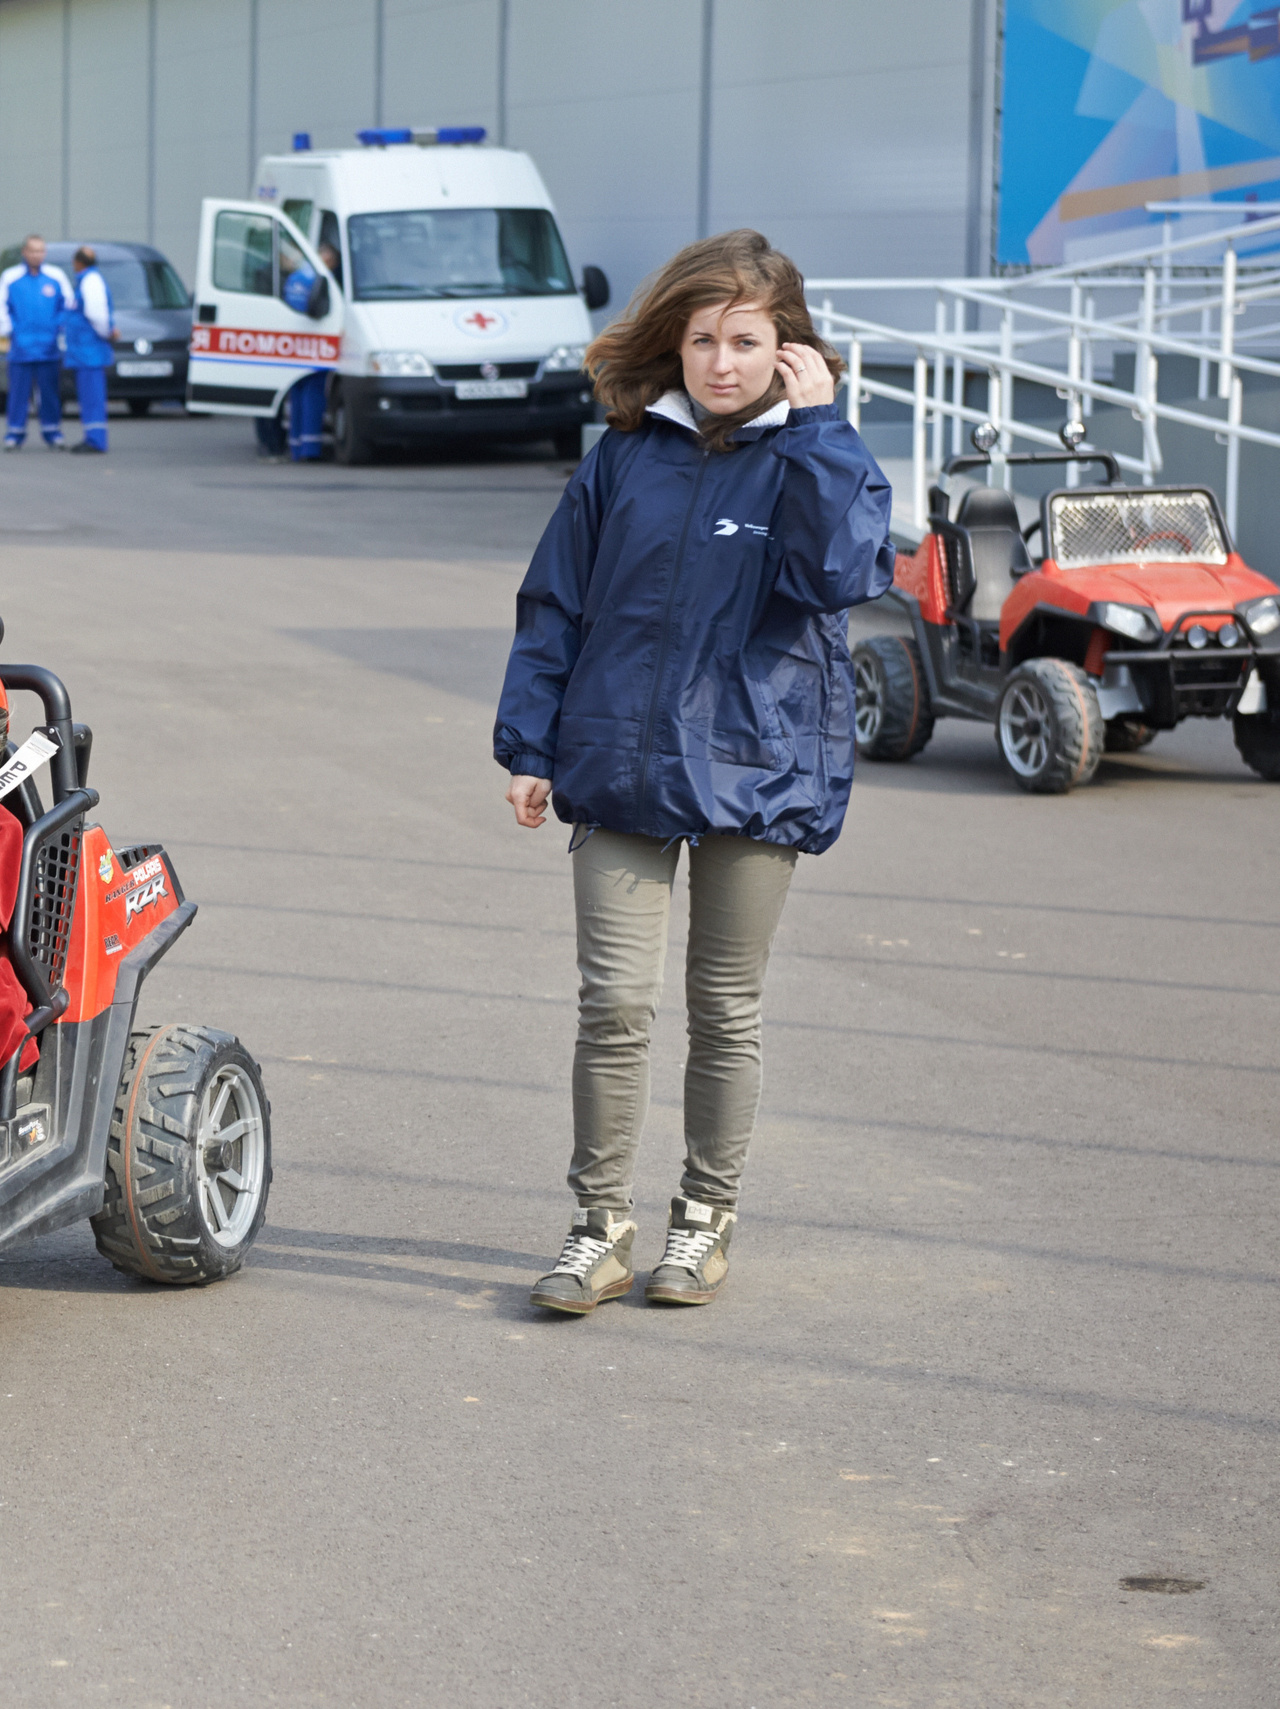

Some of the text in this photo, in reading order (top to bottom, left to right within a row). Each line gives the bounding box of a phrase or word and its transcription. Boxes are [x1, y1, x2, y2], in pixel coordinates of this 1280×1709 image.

[219, 331, 337, 360] ПОМОЩЬ
[132, 857, 162, 885] POLARIS
[125, 873, 169, 927] RZR
